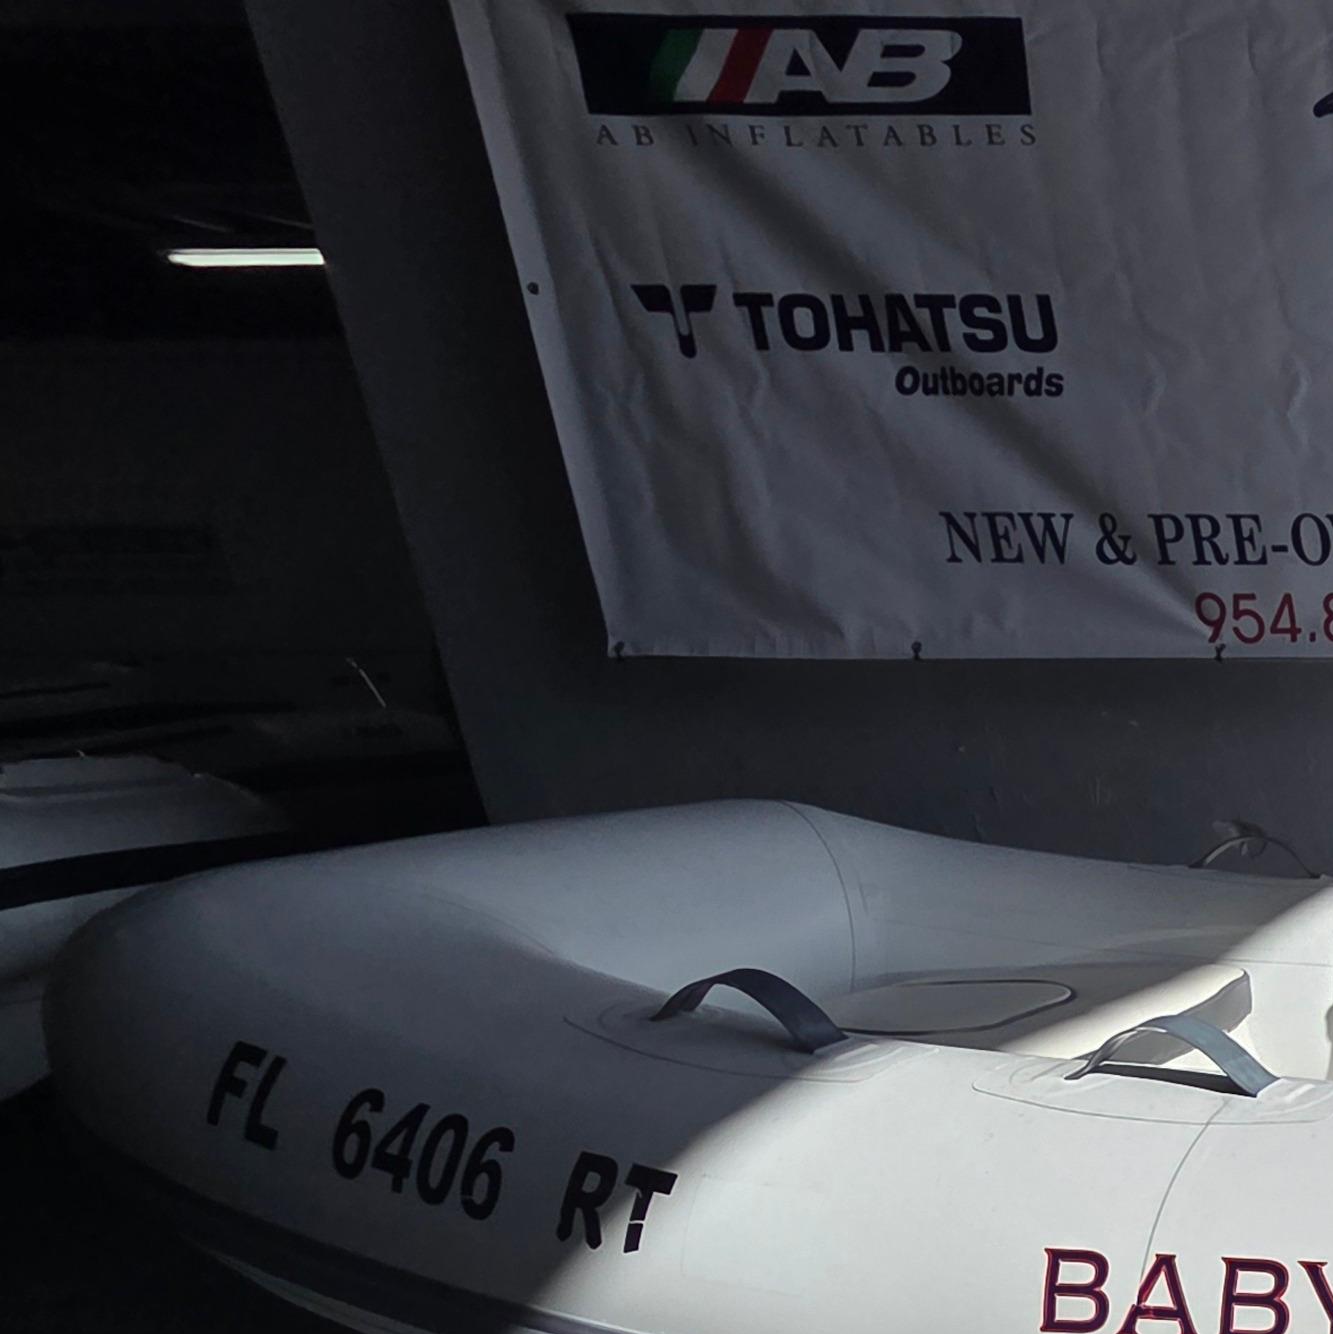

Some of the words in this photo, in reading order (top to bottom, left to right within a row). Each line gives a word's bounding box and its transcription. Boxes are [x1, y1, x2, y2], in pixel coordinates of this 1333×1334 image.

[596, 124, 654, 147] AB
[687, 124, 1036, 148] INFLATABLES
[732, 292, 1058, 353] TOHATSU
[895, 365, 1064, 398] Outboards
[938, 510, 1075, 565] NEW
[1095, 512, 1138, 566] &
[206, 1040, 287, 1151] FL
[332, 1088, 515, 1221] 6406
[555, 1150, 678, 1254] RT
